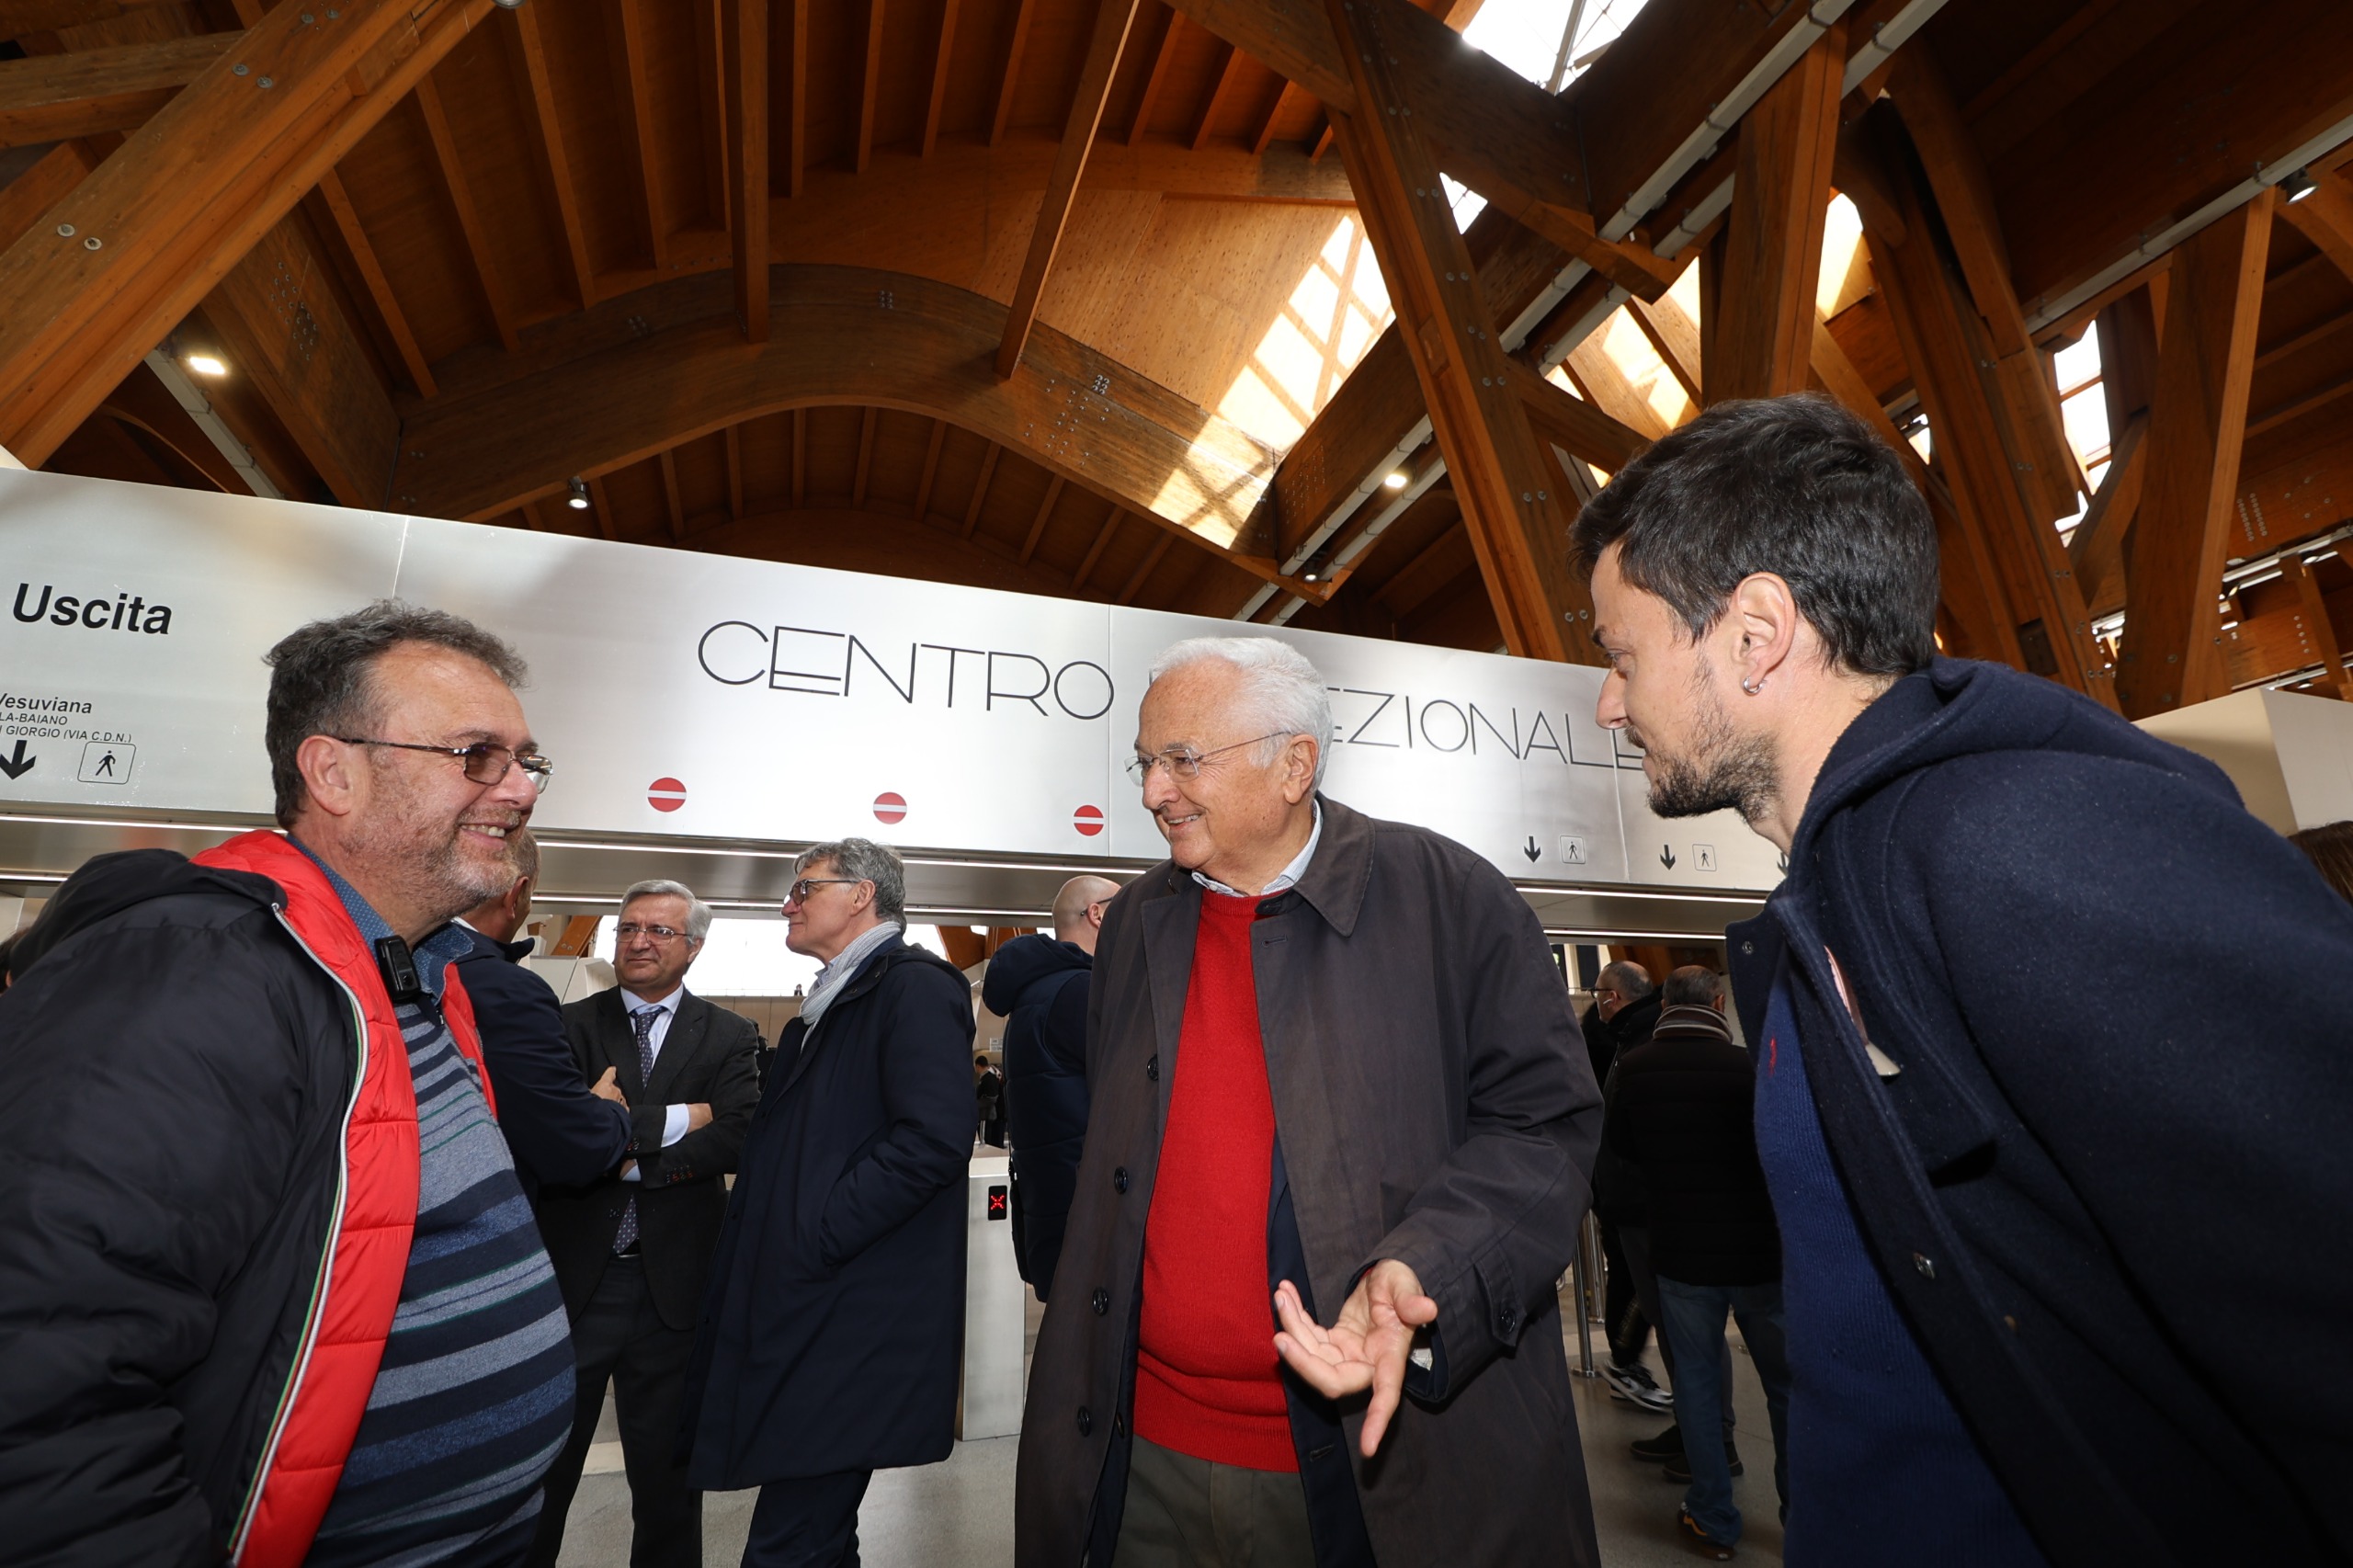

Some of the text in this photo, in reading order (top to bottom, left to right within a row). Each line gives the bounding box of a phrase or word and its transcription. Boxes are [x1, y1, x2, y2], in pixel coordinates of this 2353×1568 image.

[13, 583, 172, 635] Uscita
[698, 620, 1643, 771] CENTRO ZIONAL
[6, 725, 61, 738] GIORGIO
[63, 729, 88, 740] (VIA
[91, 732, 132, 743] C.D.N.)
